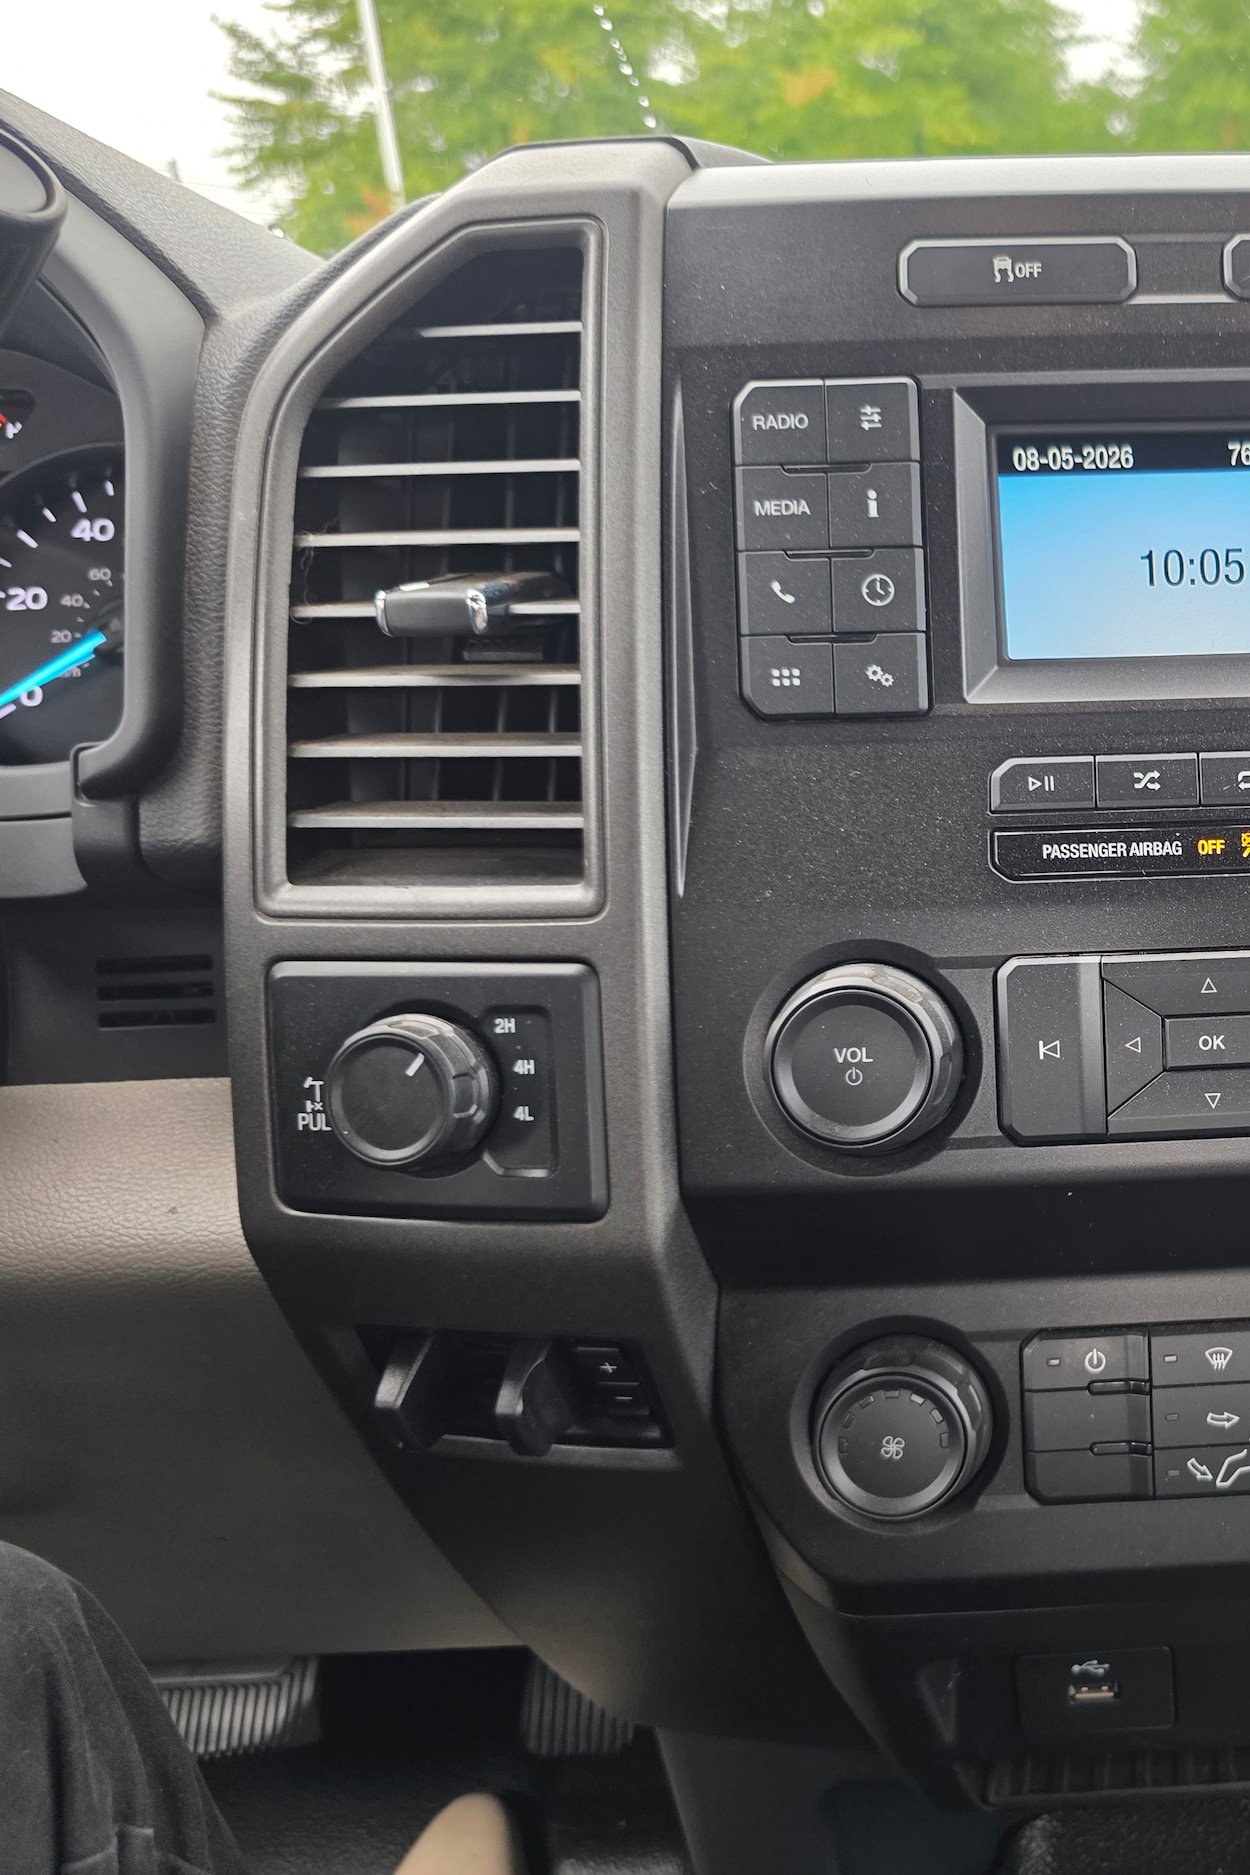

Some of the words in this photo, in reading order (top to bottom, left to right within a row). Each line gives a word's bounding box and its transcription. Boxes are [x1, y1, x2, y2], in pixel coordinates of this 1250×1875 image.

[1015, 261, 1043, 278] OFF
[752, 413, 809, 430] RADIO
[1012, 443, 1134, 471] 08-05-2026
[754, 499, 811, 516] MEDIA
[71, 518, 115, 543] 40
[88, 567, 112, 581] 60
[1140, 547, 1245, 587] 10:05
[6, 586, 48, 611] 20
[60, 594, 84, 607] 40
[51, 630, 72, 643] 20
[20, 685, 43, 708] 0
[1042, 843, 1127, 860] PASSENGER
[1129, 840, 1182, 858] AIRBAG
[1198, 839, 1226, 856] OFF
[494, 1018, 516, 1034] 2H
[1198, 1034, 1226, 1051] OK
[834, 1047, 873, 1064] VOL
[513, 1059, 535, 1075] 4H
[297, 1112, 333, 1131] PUL
[513, 1106, 534, 1122] 4L
